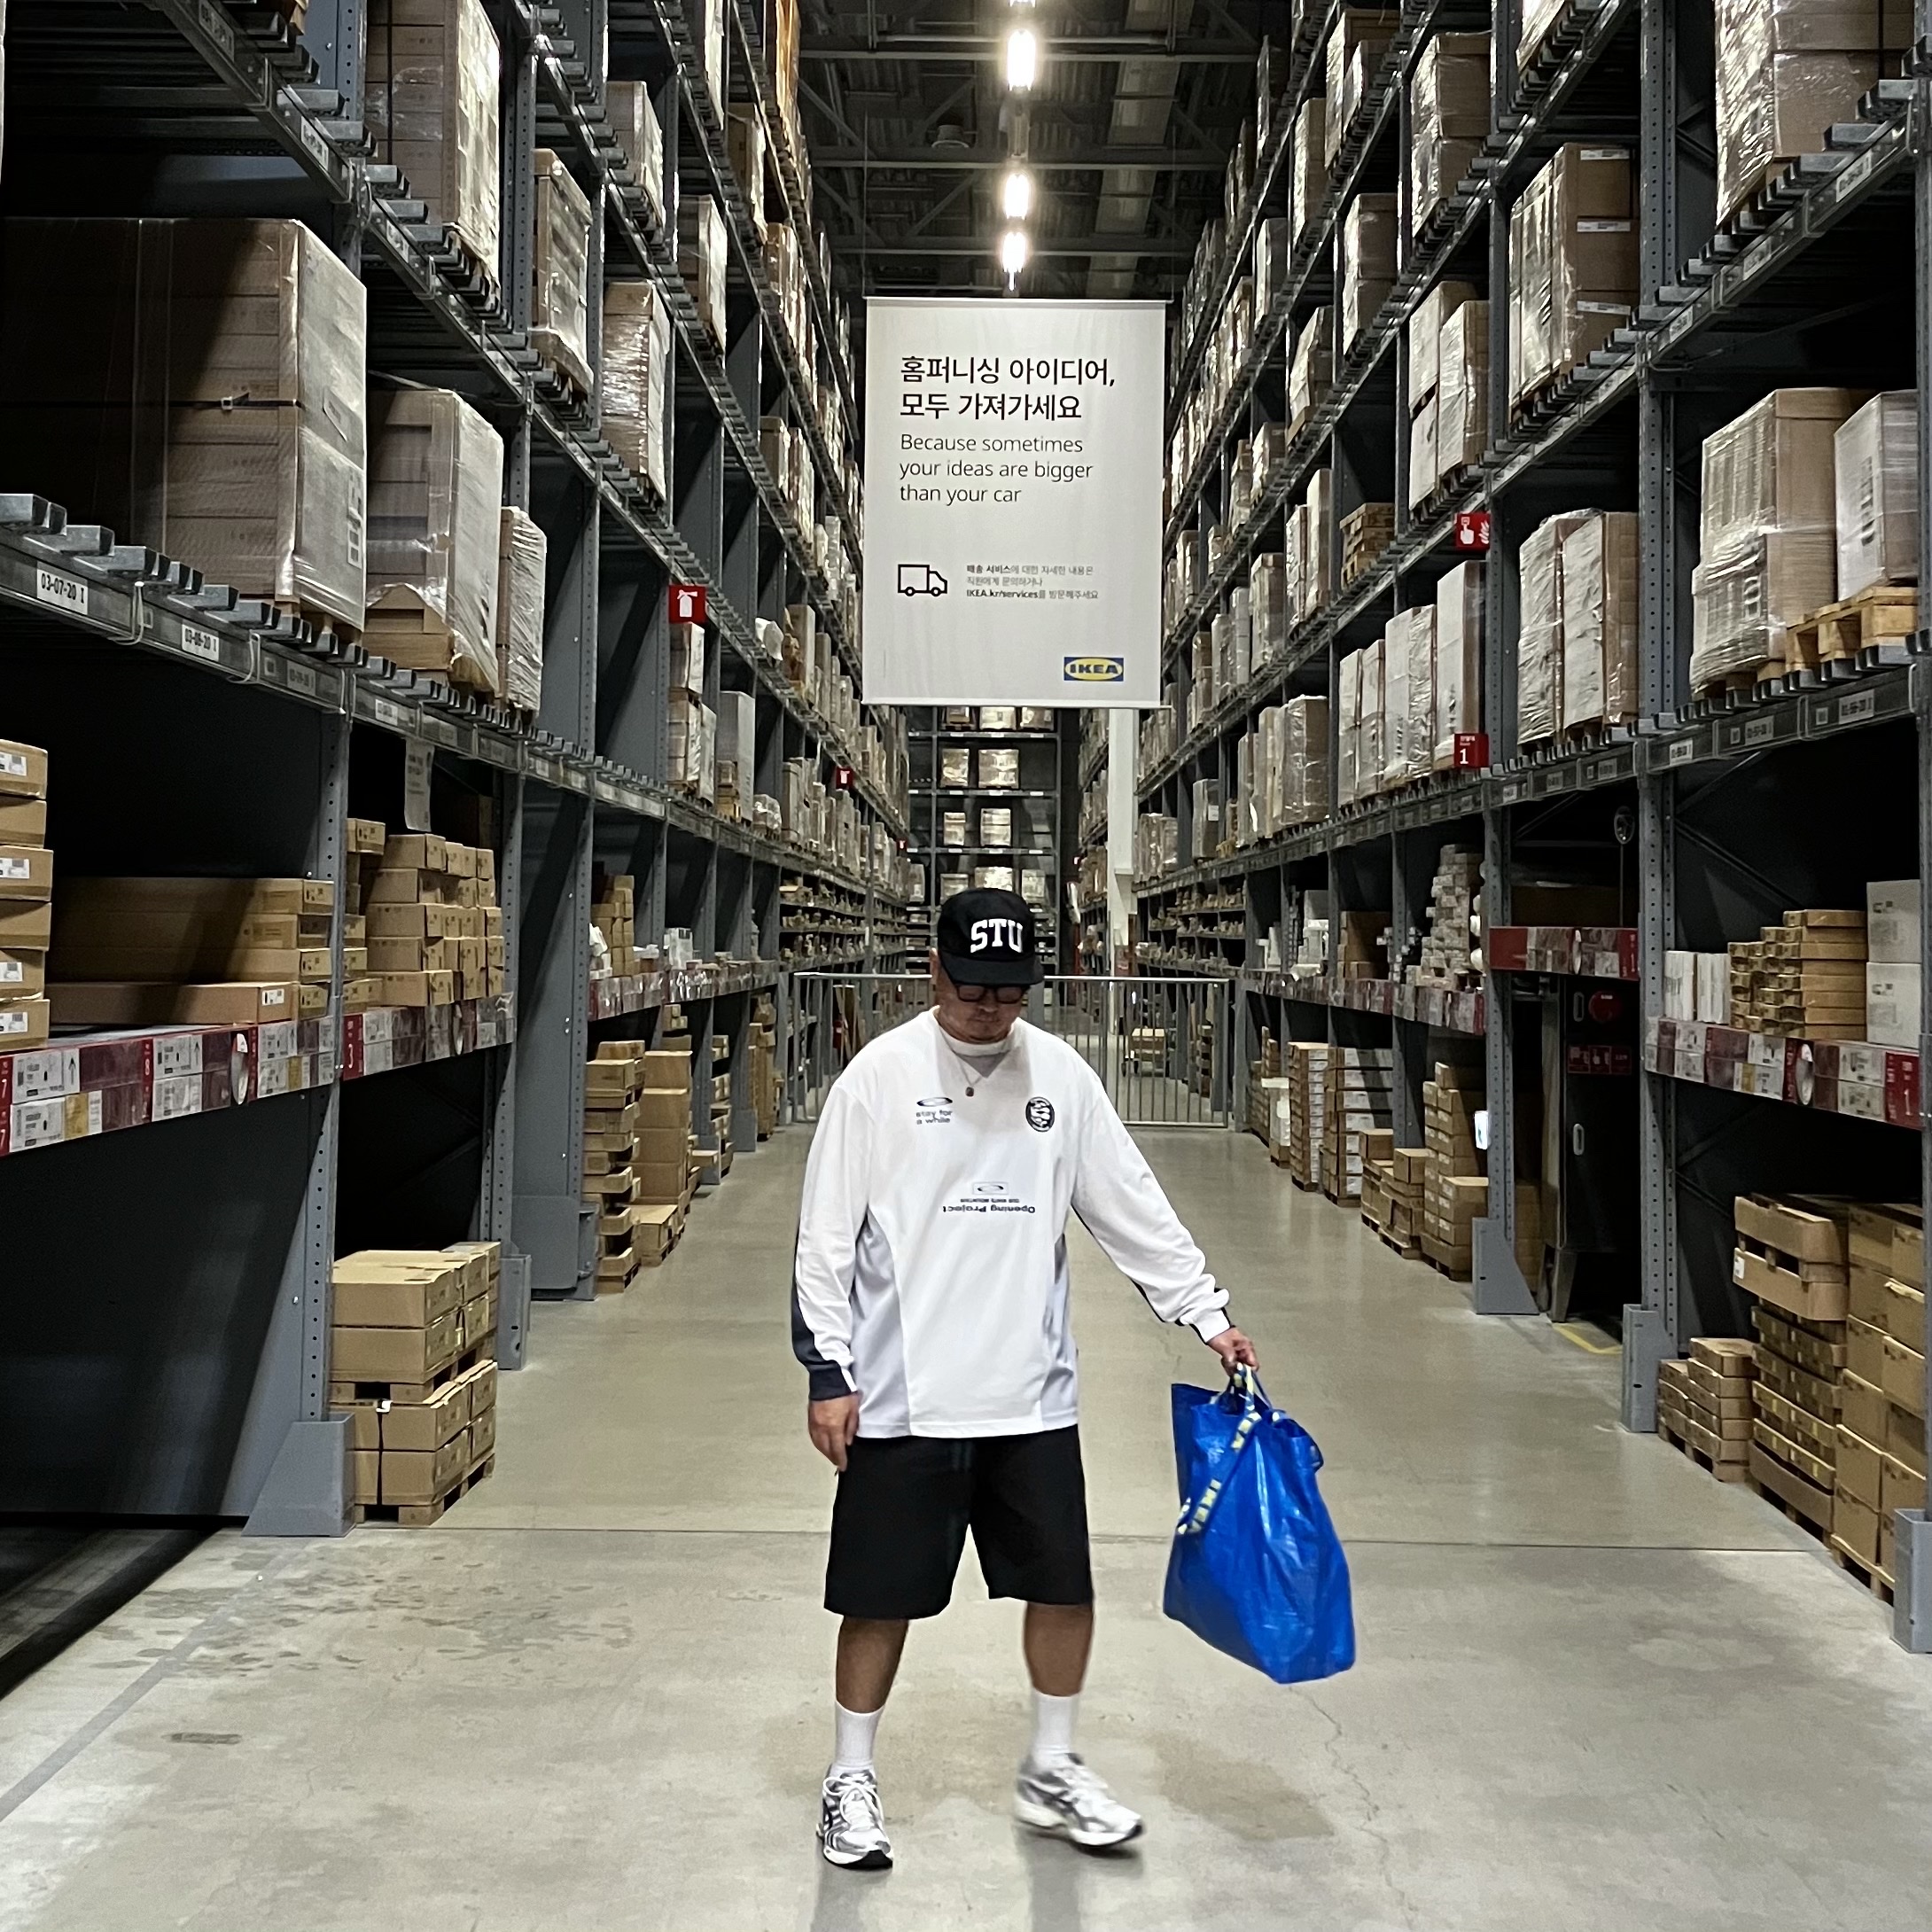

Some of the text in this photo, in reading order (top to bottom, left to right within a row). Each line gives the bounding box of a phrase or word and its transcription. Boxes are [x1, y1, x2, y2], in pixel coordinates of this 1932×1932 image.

[900, 355, 1116, 387] 홈퍼니싱 아이디어,
[900, 393, 1082, 422] 모두 가져가세요
[900, 433, 1083, 453] Because sometimes
[899, 459, 1094, 483] your ideas are bigger
[900, 484, 1022, 507] than your car
[41, 573, 77, 601] 03-07-20
[1070, 664, 1118, 674] IKEA
[1459, 748, 1469, 765] 1
[970, 917, 1024, 954] STU
[942, 1204, 1036, 1214] Opening Project
